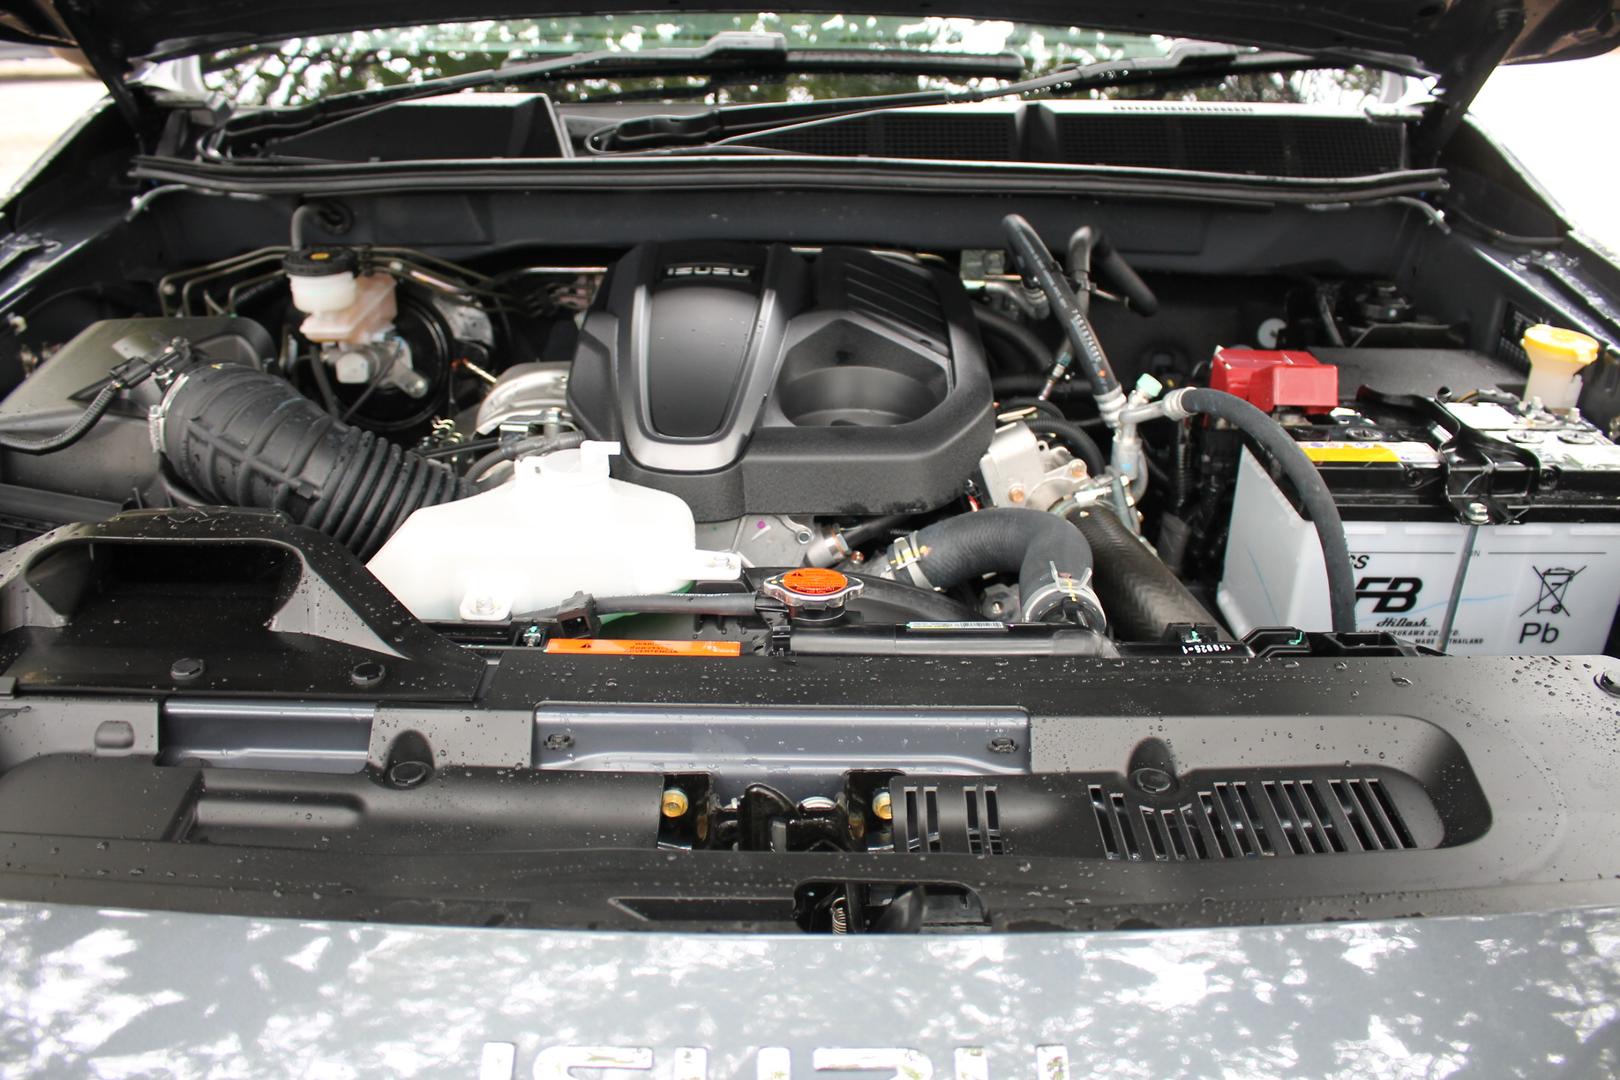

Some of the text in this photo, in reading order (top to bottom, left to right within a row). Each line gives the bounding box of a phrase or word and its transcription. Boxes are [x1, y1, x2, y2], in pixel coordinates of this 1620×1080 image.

[667, 266, 750, 277] ISUZU
[1355, 577, 1424, 613] FB
[1519, 622, 1559, 644] Pb
